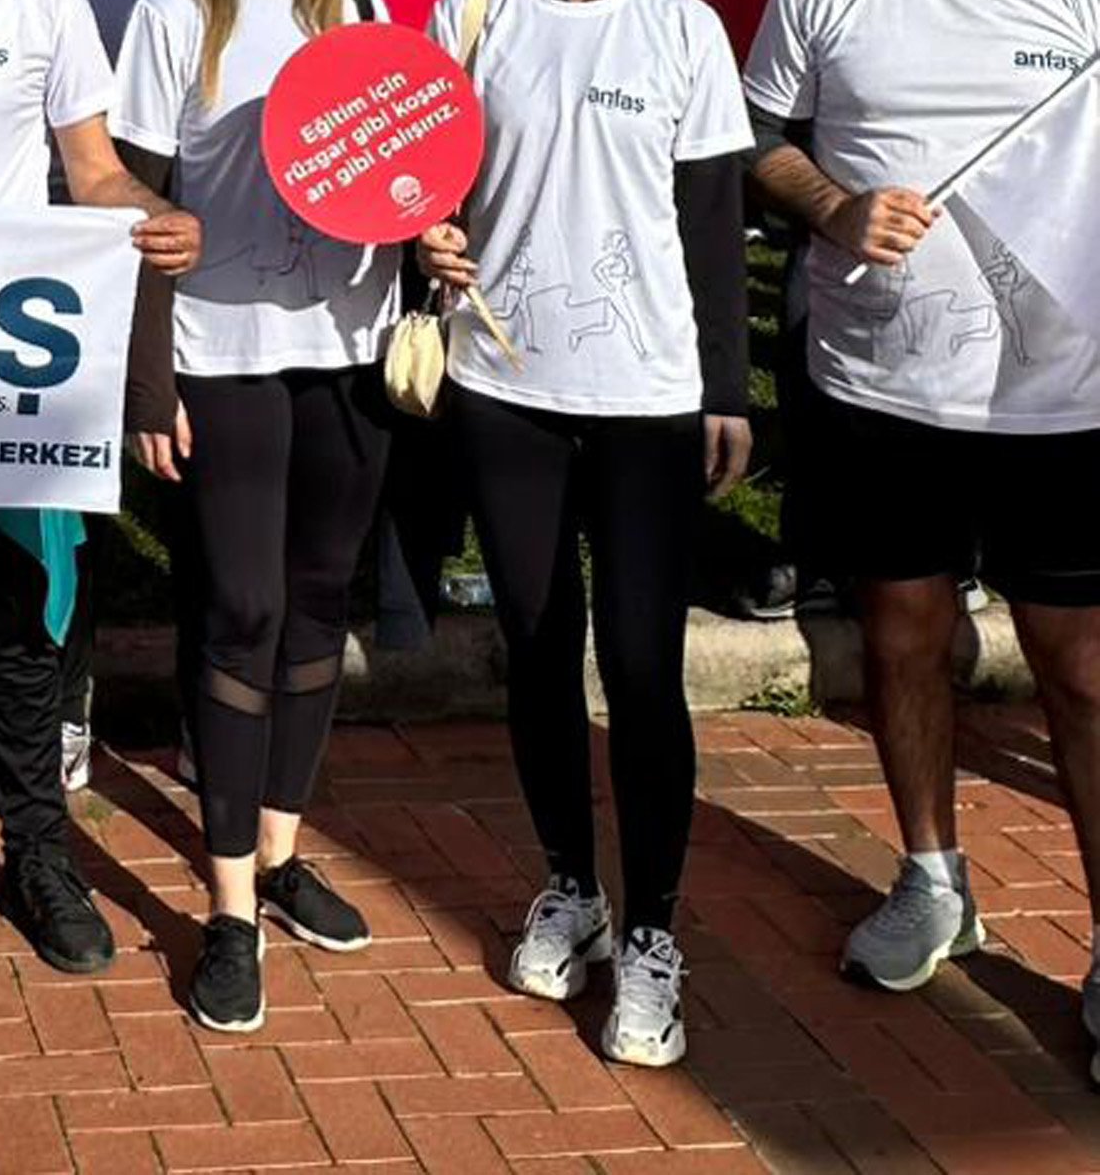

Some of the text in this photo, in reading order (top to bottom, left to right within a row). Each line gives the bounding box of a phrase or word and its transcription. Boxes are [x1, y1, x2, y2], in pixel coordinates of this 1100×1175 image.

[300, 71, 410, 145] Eğitim için
[587, 86, 645, 114] anfaş
[283, 138, 350, 188] rüzgar
[350, 108, 392, 148] gibi
[334, 150, 377, 188] gibi
